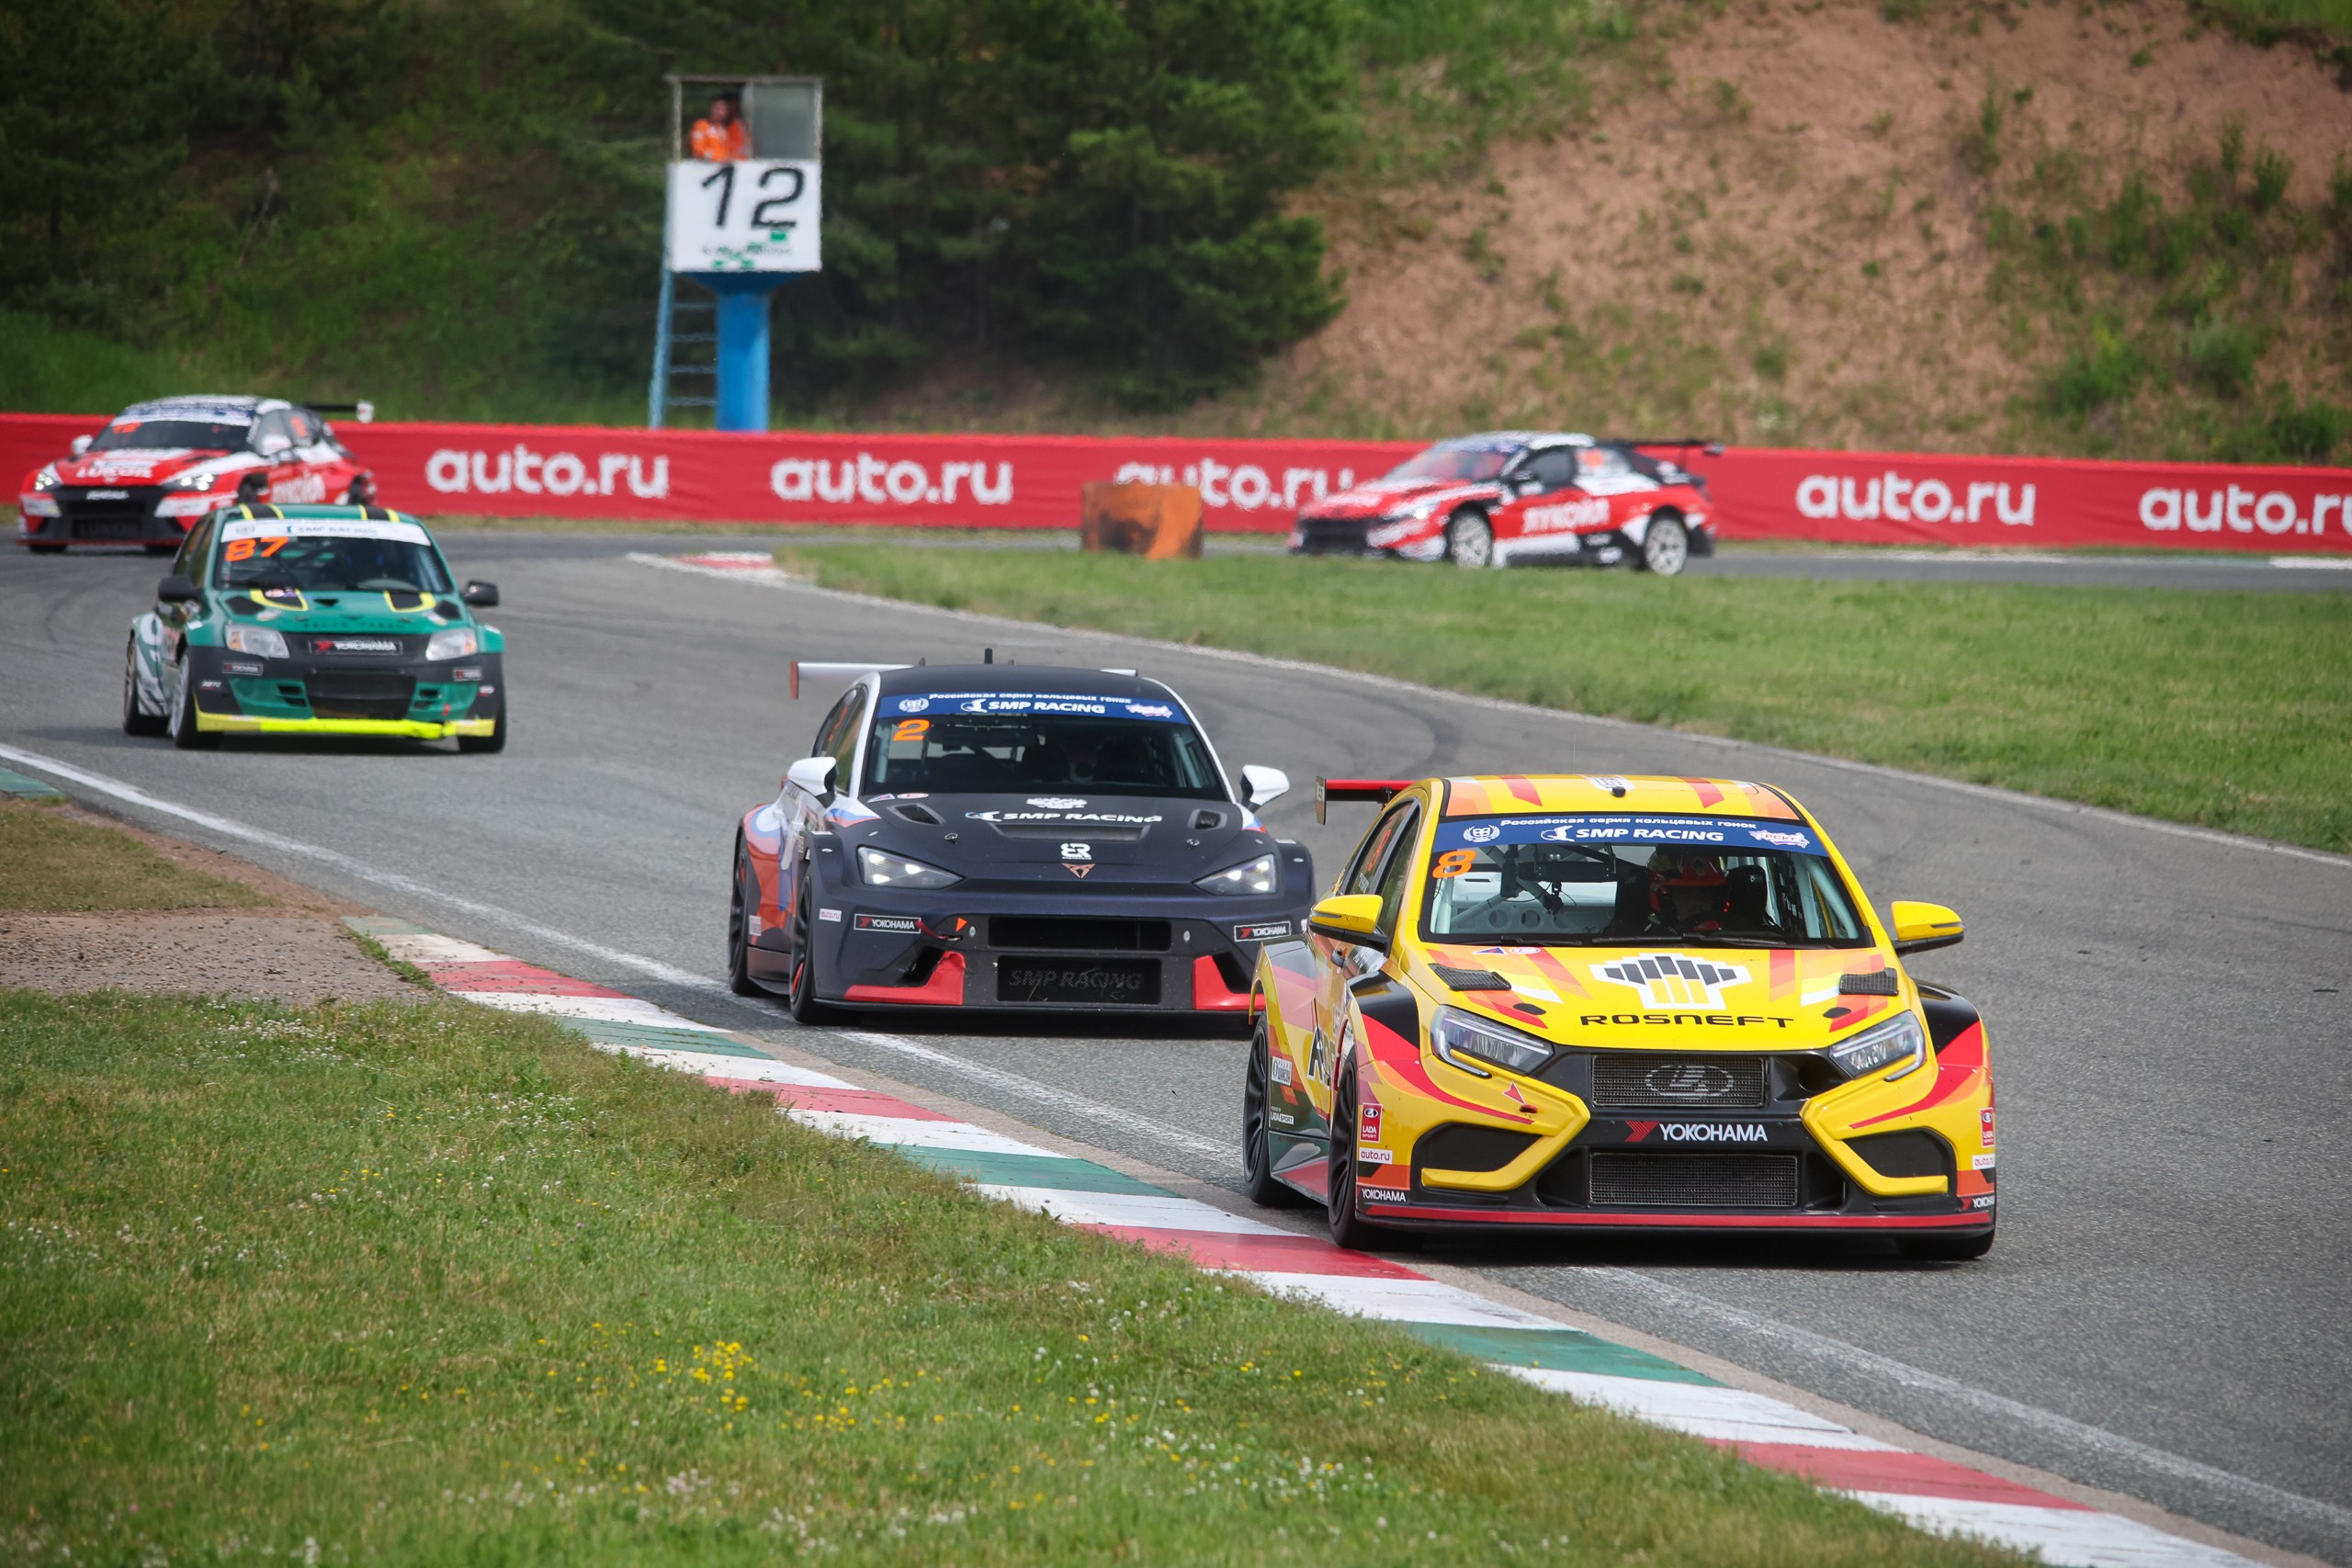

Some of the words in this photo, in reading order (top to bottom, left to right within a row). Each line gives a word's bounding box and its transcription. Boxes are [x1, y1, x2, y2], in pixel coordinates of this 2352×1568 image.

[702, 164, 805, 228] 12
[426, 444, 669, 499] auto.ru
[771, 452, 1013, 505] auto.ru
[1796, 471, 2036, 525] auto.ru
[224, 536, 289, 561] 87
[334, 640, 397, 650] YOKOHAMA
[988, 701, 1032, 710] SMP
[1034, 702, 1105, 714] RACING
[892, 718, 931, 741] 2
[1065, 813, 1162, 823] RACING
[1500, 818, 1585, 827] Российская
[1635, 818, 1713, 827] кольцевых
[1717, 821, 1757, 829] гонок
[1576, 828, 1629, 838] SMP
[1633, 829, 1724, 841] RACING
[1431, 850, 1476, 879] 8
[871, 919, 915, 930] YOKOHAMA
[1251, 926, 1287, 937] YOKOHAMA
[1010, 970, 1057, 986] SMP
[1060, 971, 1143, 989] RACING
[1580, 1014, 1794, 1028] ROSNEFT
[1362, 1125, 1377, 1134] LADA
[1659, 1122, 1768, 1142] YOKOHAMA
[1361, 1149, 1390, 1161] auto.ru
[1362, 1188, 1407, 1202] YOKOHAMA
